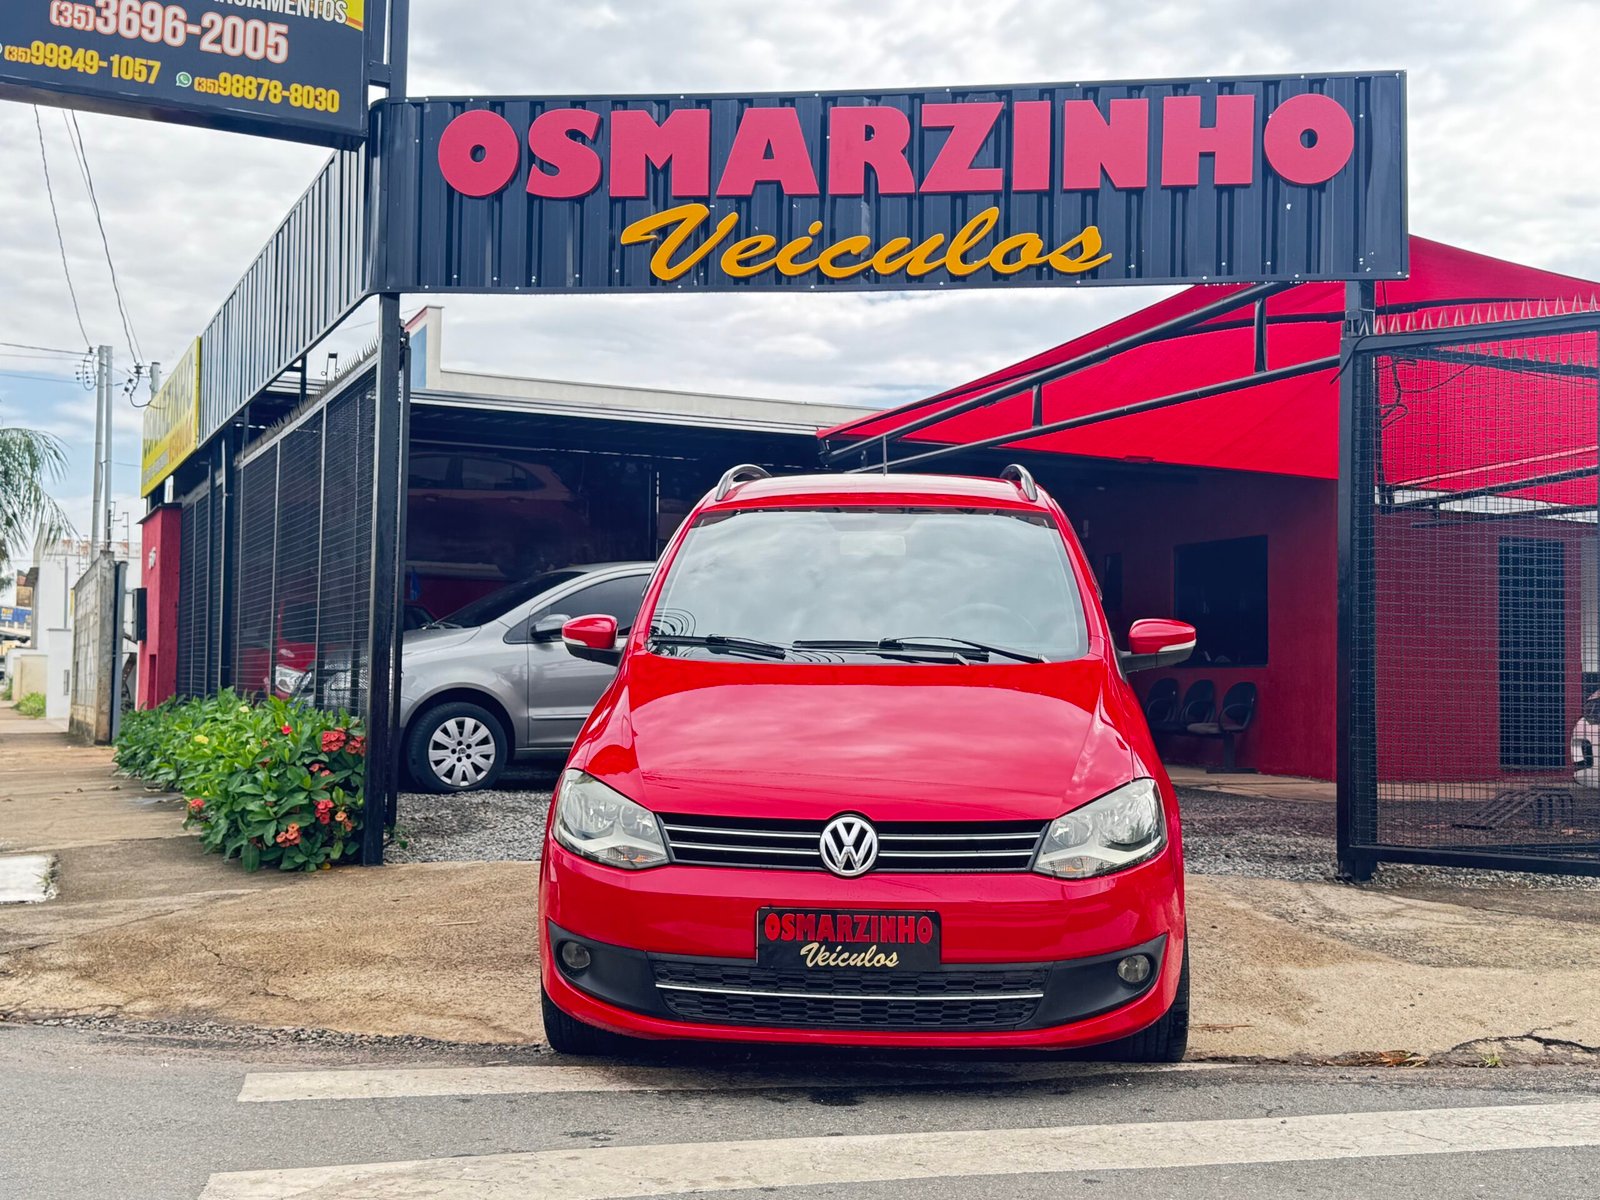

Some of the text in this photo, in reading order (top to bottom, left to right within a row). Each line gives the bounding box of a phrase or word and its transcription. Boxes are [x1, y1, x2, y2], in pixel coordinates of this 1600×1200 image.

[50, 0, 289, 64] (35)3696-2005
[194, 71, 340, 113] (35)98878-8030
[437, 94, 1355, 198] OSMARZINHO
[764, 912, 934, 944] OSMARZINHO
